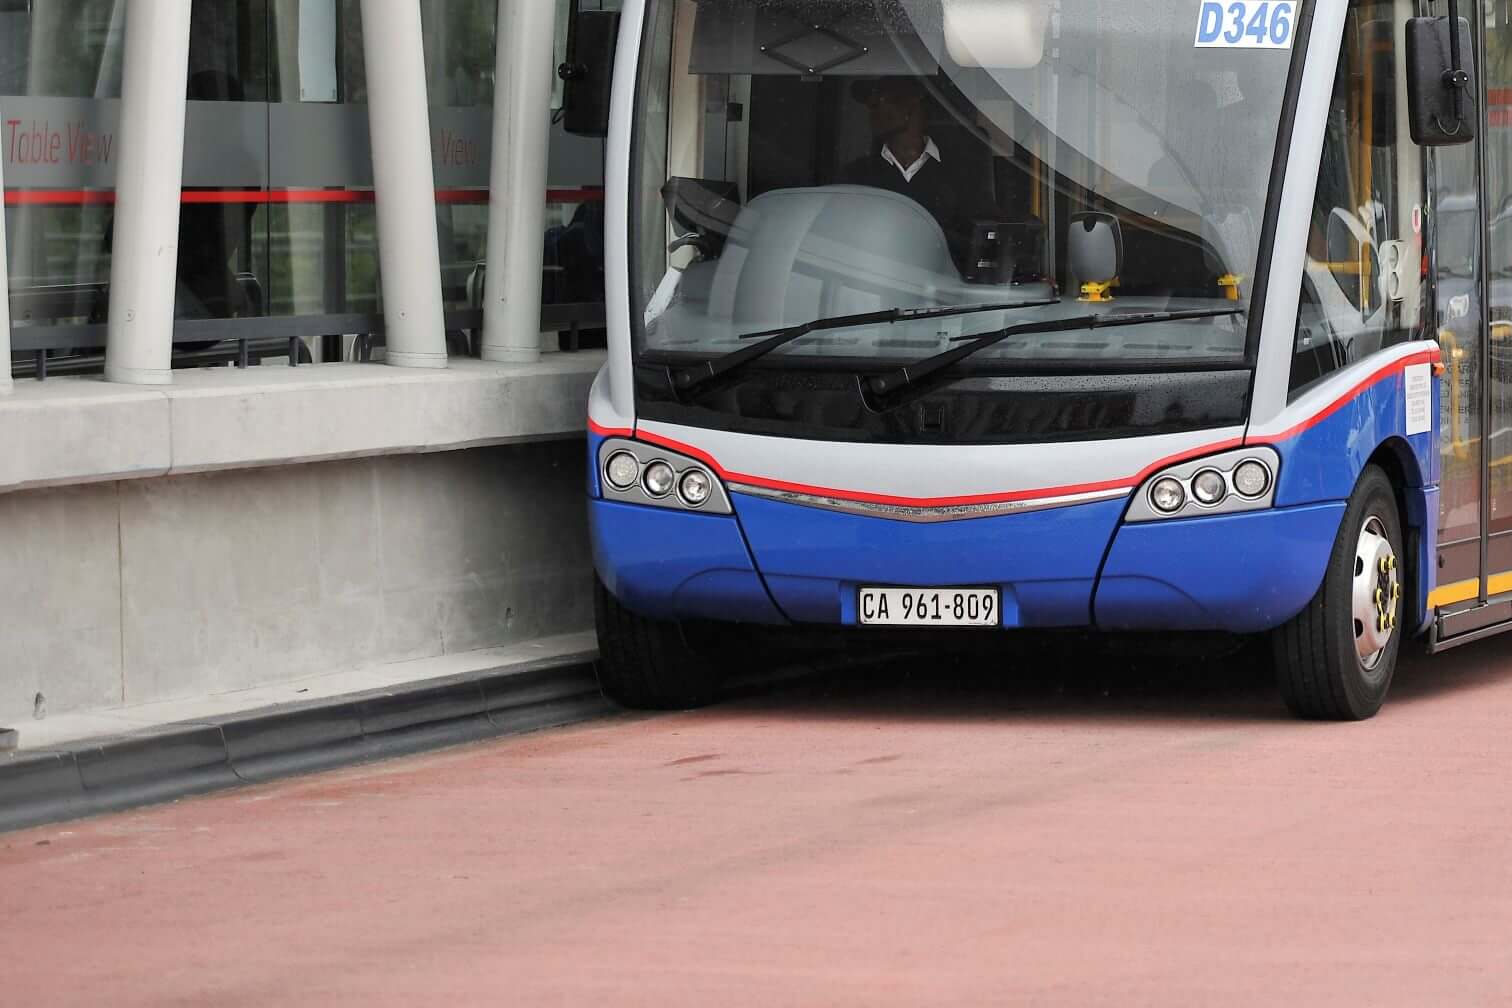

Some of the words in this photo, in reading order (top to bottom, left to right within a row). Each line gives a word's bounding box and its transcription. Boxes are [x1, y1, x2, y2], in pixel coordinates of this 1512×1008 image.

[1198, 2, 1292, 45] D346
[7, 119, 62, 164] Table
[65, 119, 113, 165] View
[863, 593, 890, 620] CA
[902, 593, 994, 621] 961-809
